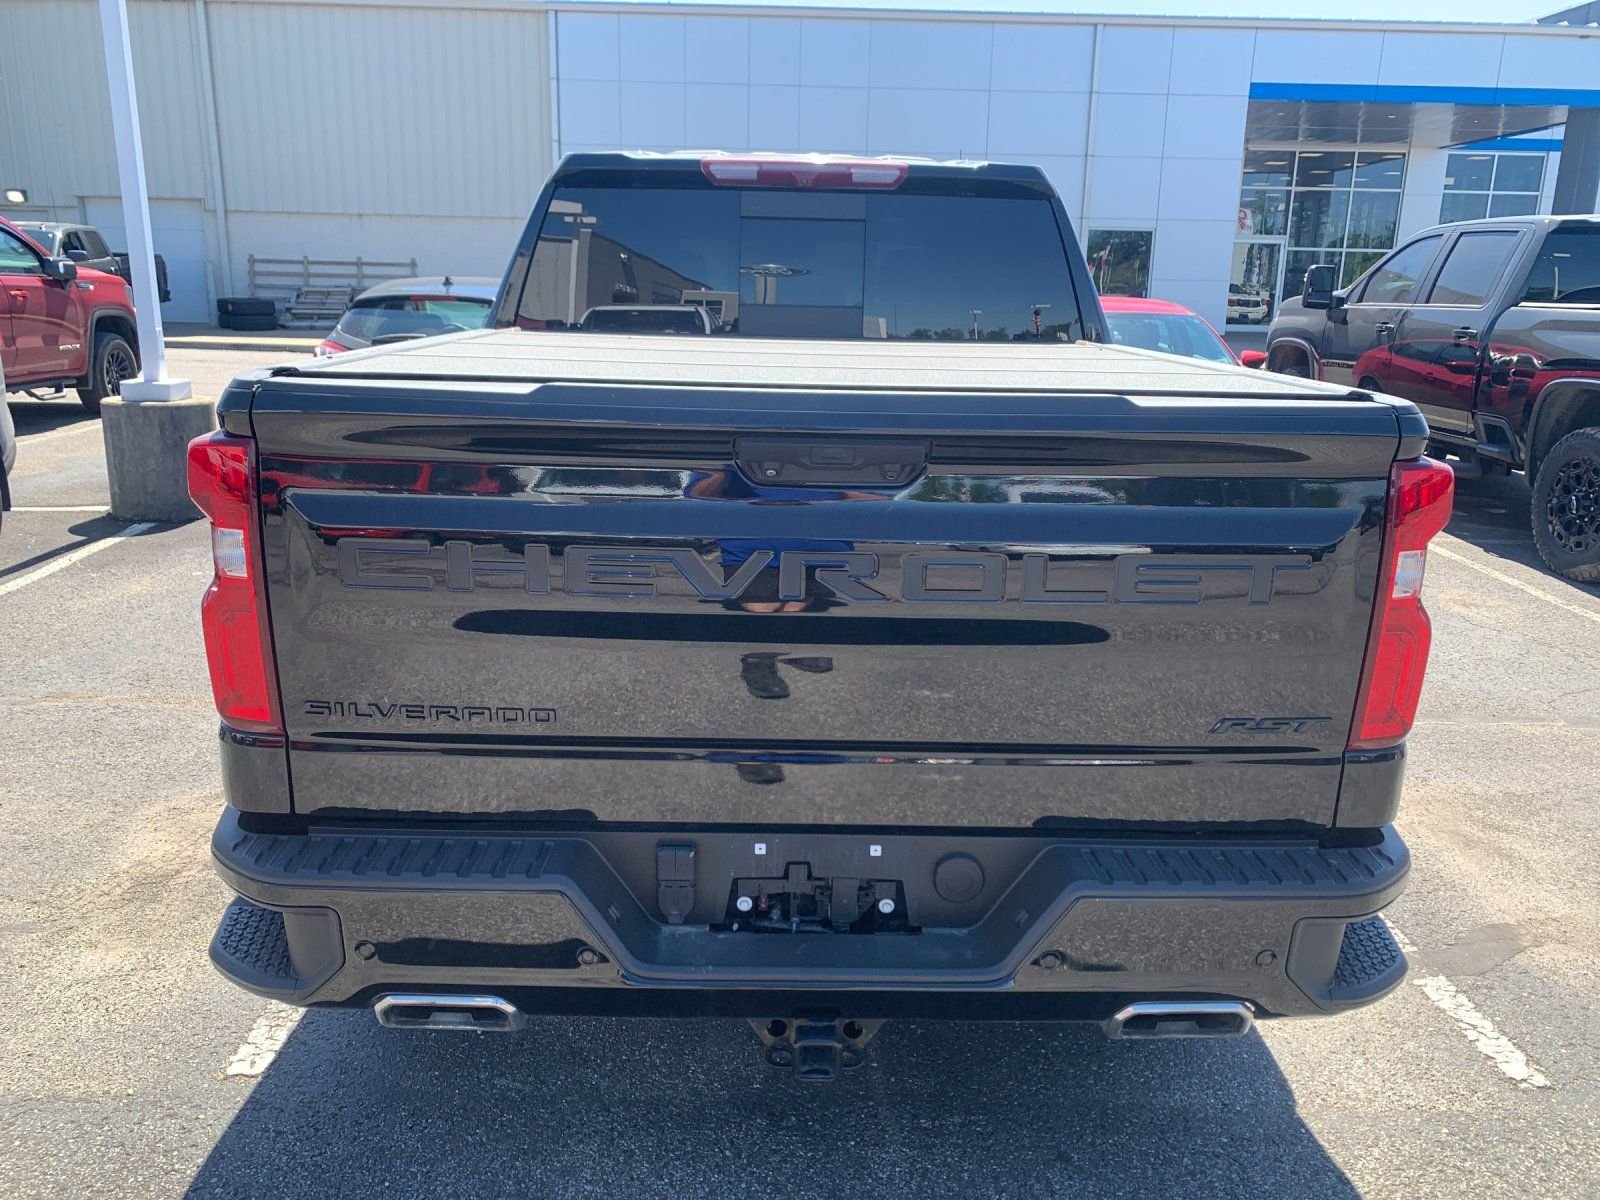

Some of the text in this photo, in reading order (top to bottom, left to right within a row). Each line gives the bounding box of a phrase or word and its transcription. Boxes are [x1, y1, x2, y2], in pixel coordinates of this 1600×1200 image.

[337, 537, 1312, 604] CHEVROLET
[304, 700, 557, 722] SILVERADO
[1208, 716, 1332, 734] RST
